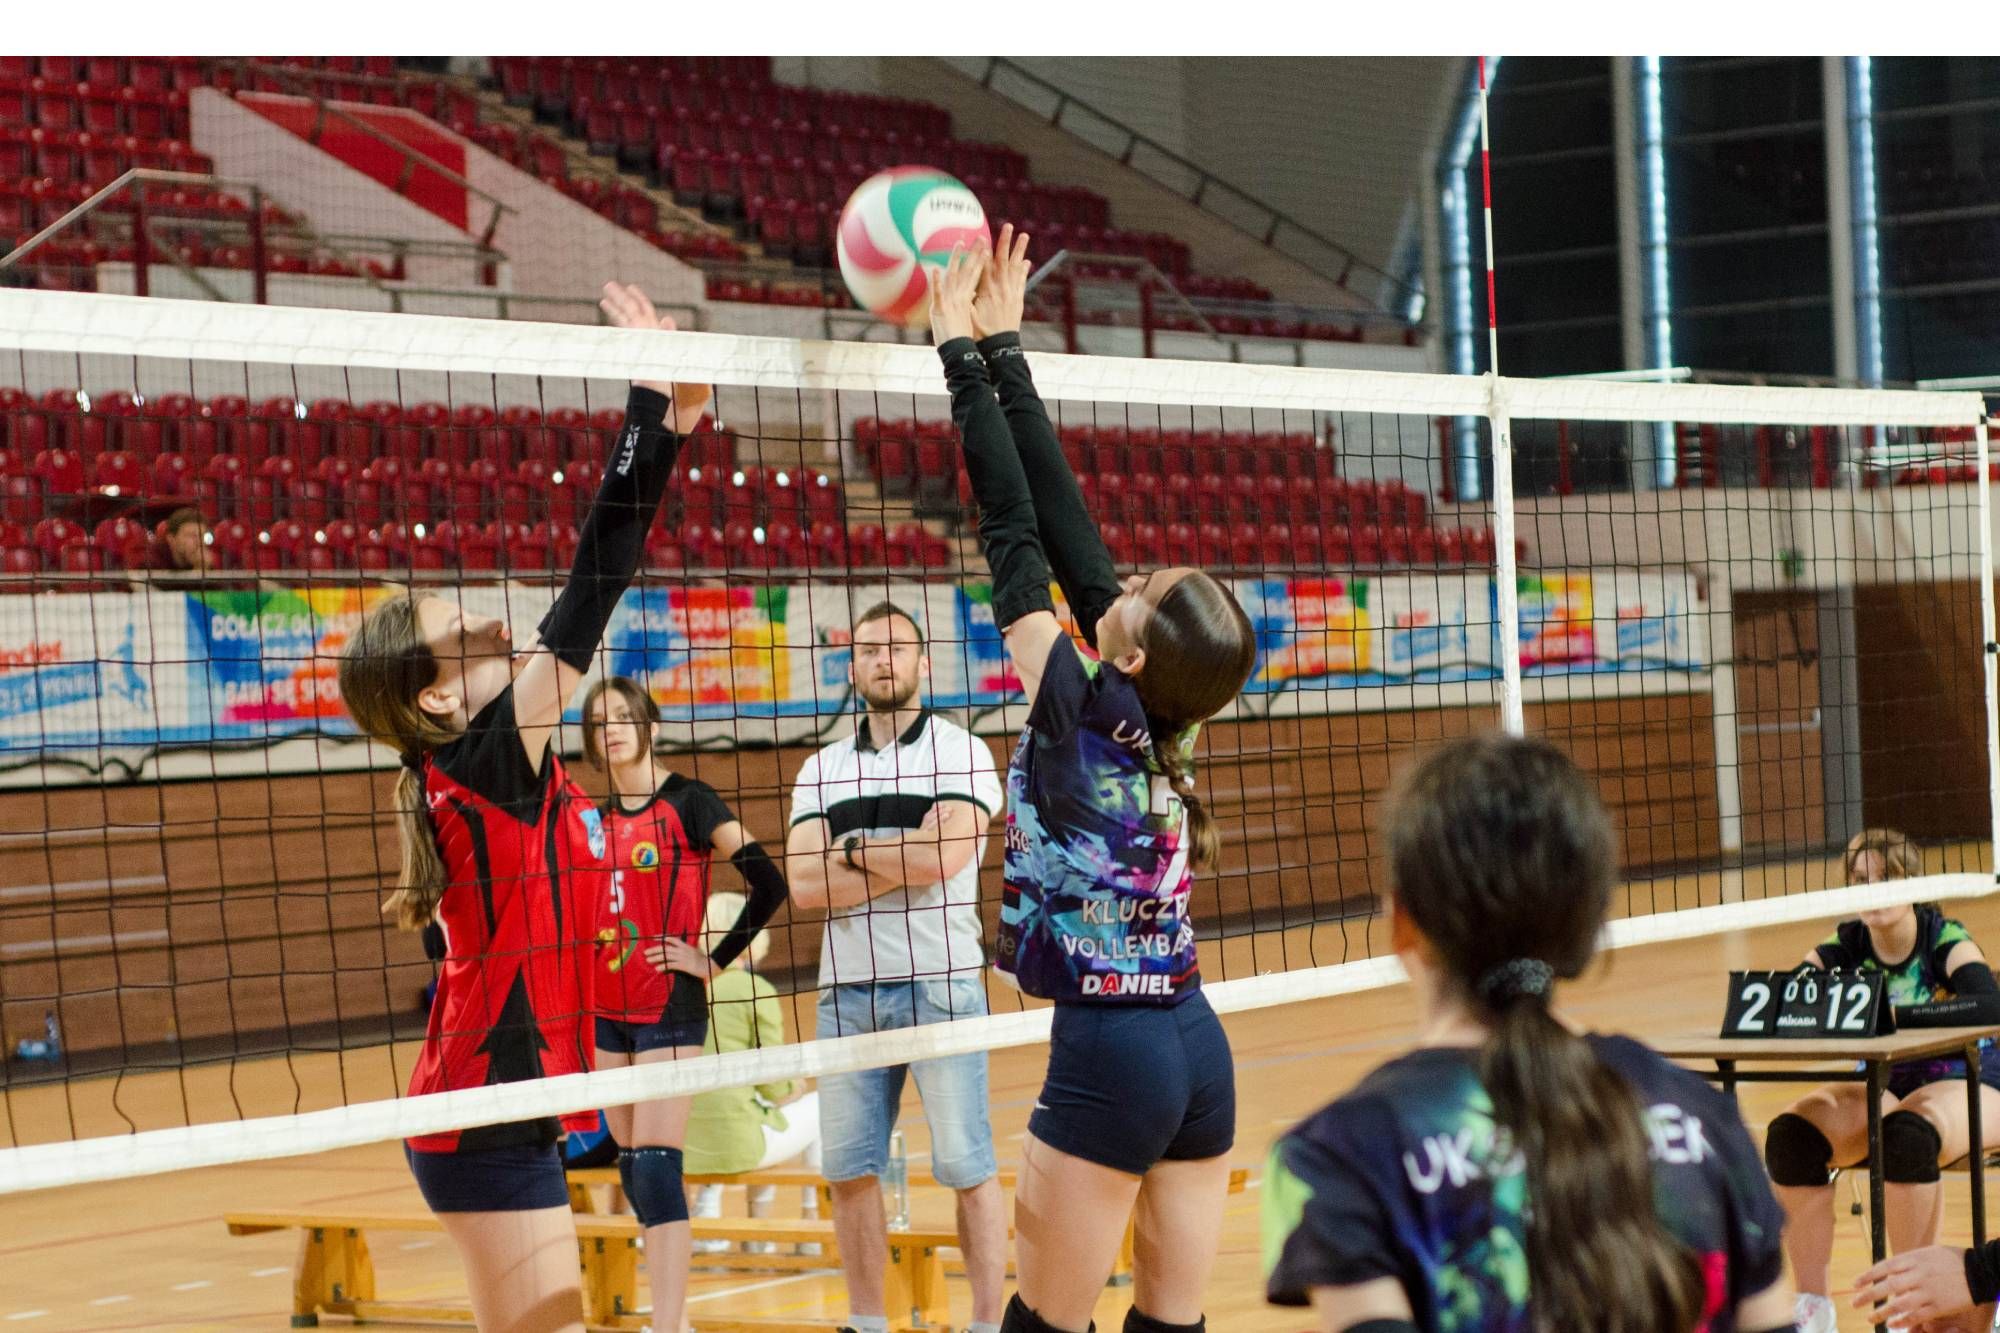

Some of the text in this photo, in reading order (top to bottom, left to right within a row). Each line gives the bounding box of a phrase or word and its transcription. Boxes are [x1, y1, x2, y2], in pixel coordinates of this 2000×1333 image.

[1082, 973, 1175, 996] DANIEL
[1737, 982, 1771, 1031] 2
[1825, 982, 1872, 1031] 12
